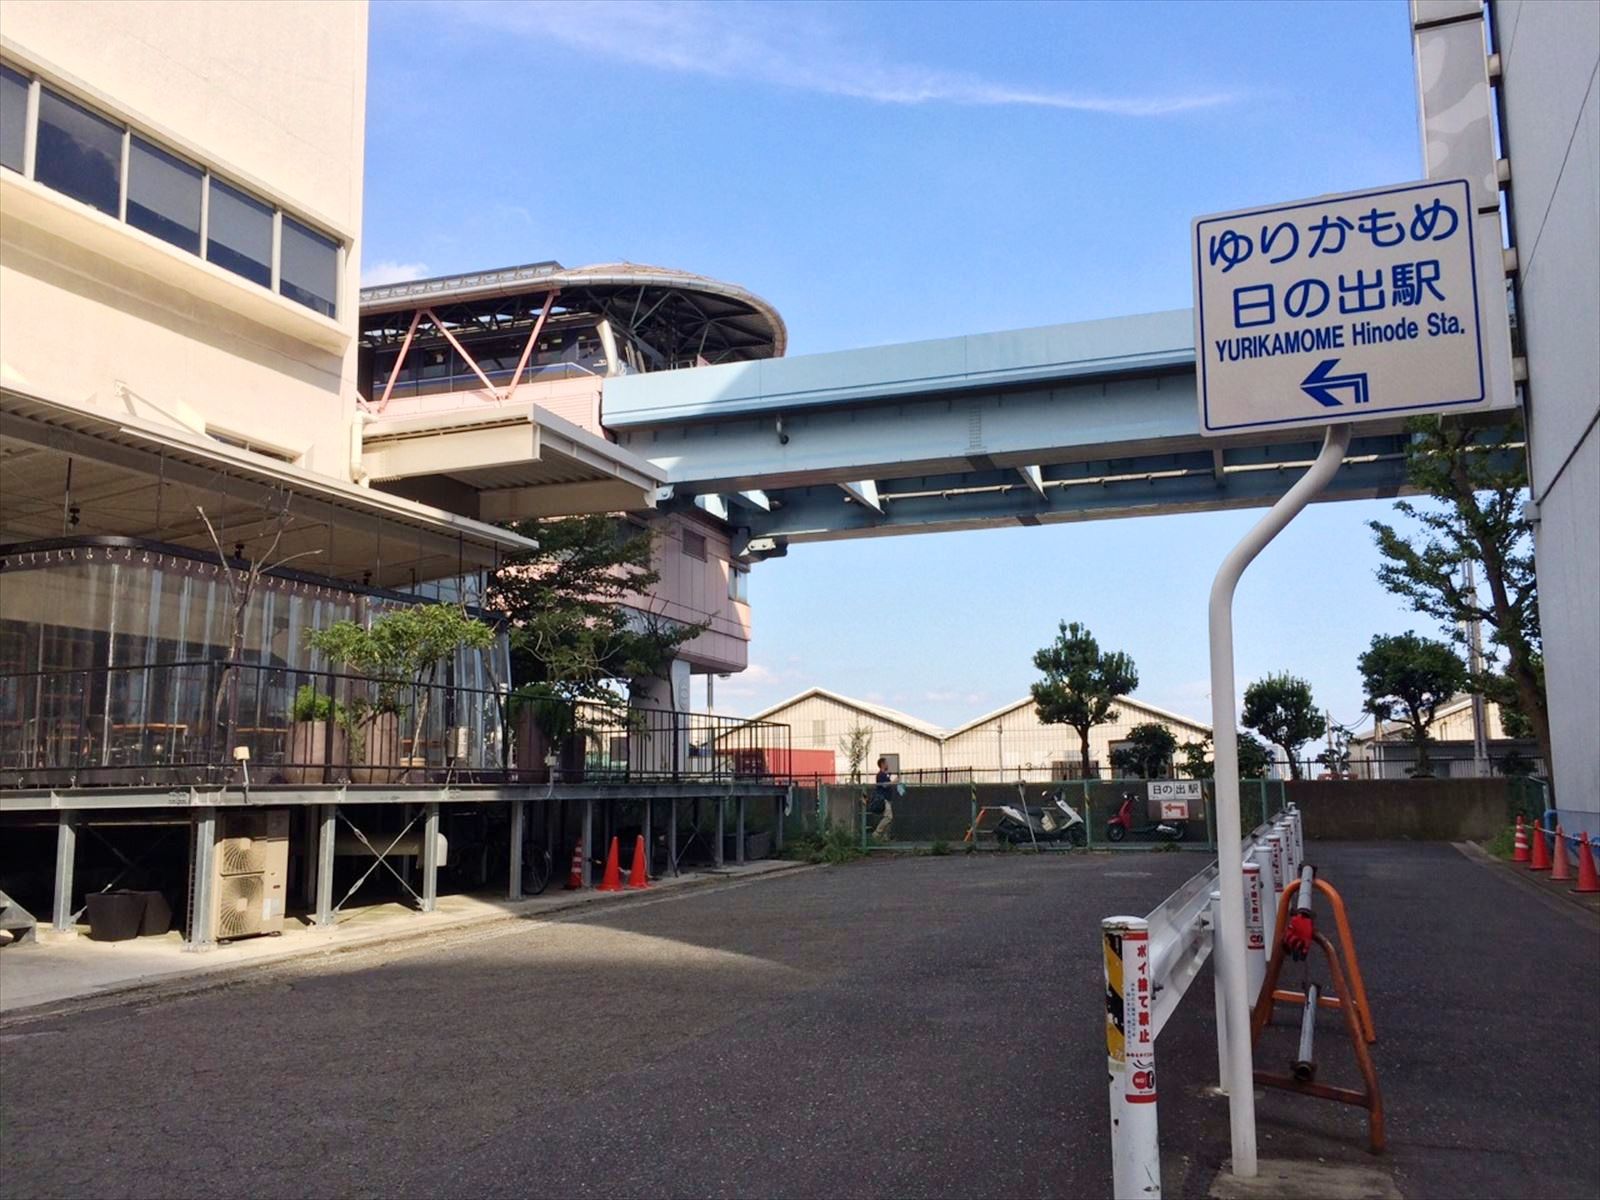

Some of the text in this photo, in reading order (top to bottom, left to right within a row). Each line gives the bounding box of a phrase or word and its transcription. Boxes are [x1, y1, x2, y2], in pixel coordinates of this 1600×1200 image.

[1209, 198, 1459, 273] ゆりかもめ
[1232, 259, 1446, 329] 日の出駅
[1215, 312, 1466, 362] YURIKAMOME Hinode Sta.
[1153, 783, 1200, 795] 日の出駅
